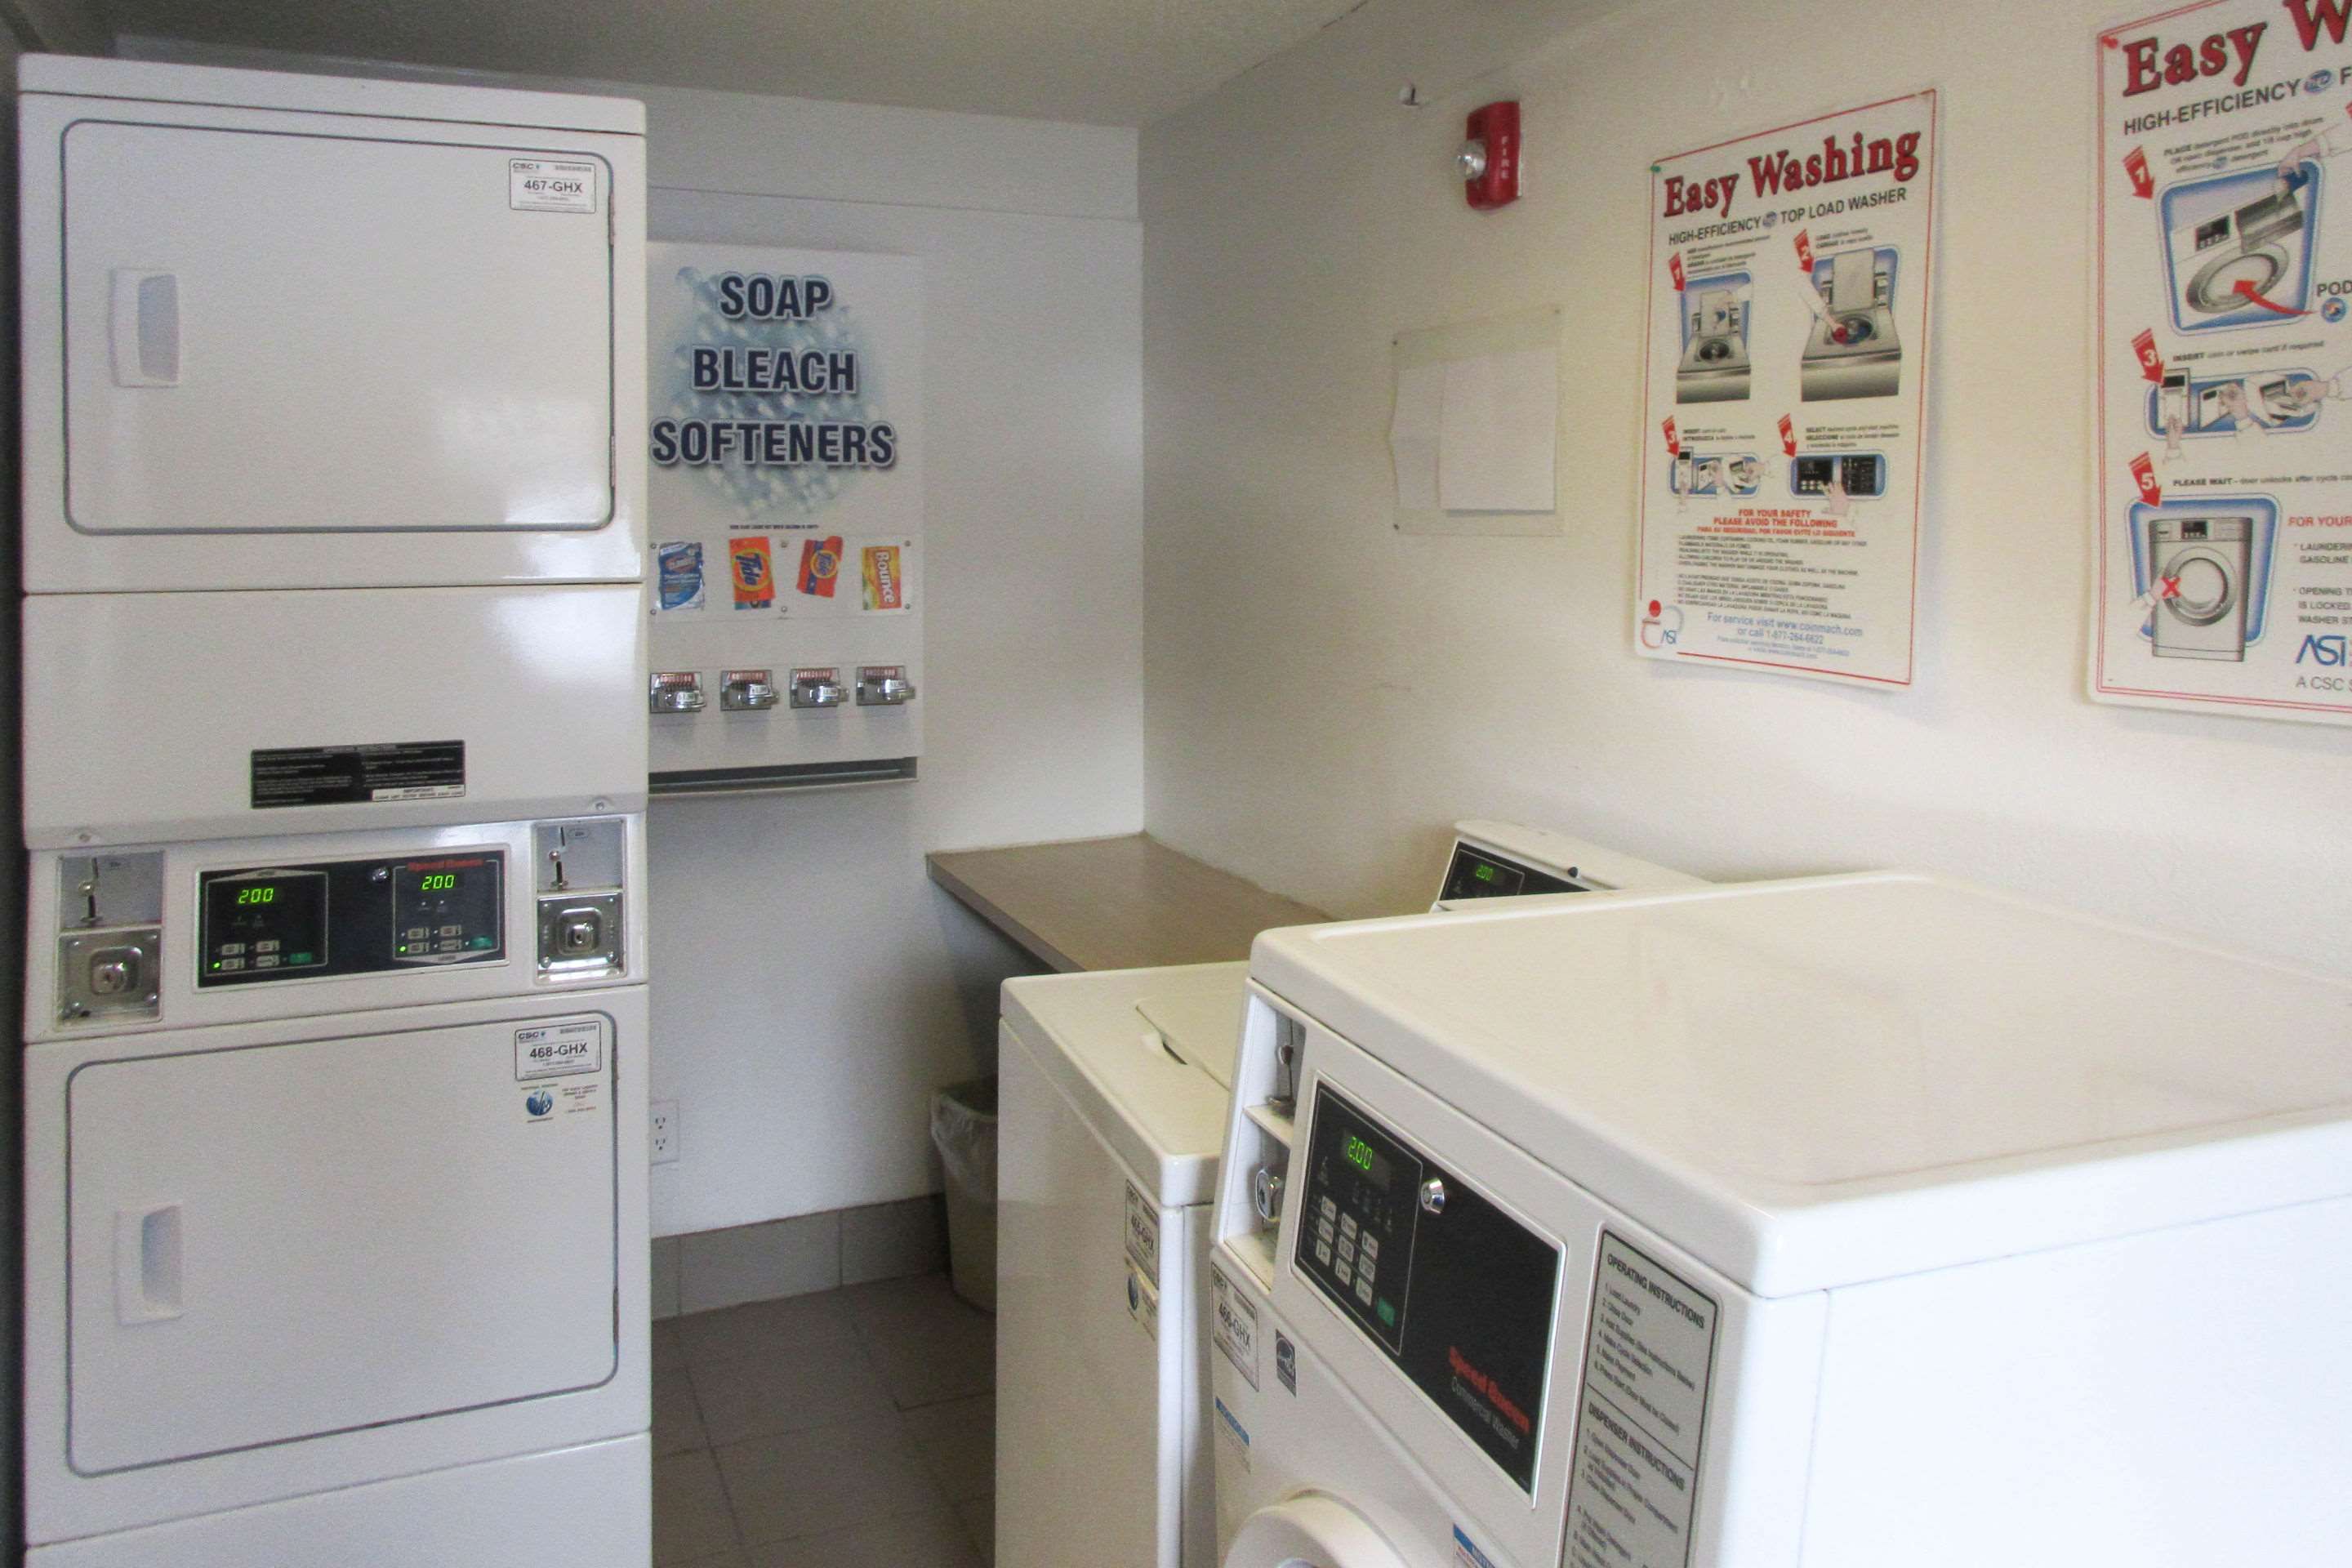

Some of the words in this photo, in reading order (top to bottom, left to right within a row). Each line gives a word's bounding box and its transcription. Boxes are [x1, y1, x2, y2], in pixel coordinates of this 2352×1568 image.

[2122, 20, 2268, 96] Easy
[2123, 78, 2300, 136] HIGH-EFFICIENCY
[1501, 136, 1510, 179] FIRE
[1663, 172, 1740, 219] Easy
[1748, 131, 1921, 198] Washing
[523, 180, 583, 194] 467-GHX
[1668, 216, 1762, 246] HIGH-EFFICIENCY
[1780, 207, 1806, 225] TOP
[1809, 198, 1845, 220] LOAD
[1848, 187, 1907, 212] WASHER
[719, 274, 831, 318] SOAP
[693, 348, 855, 392] BLEACH
[2144, 349, 2157, 367] 3
[652, 420, 893, 465] SOFTENERS
[2140, 473, 2154, 491] 5
[2173, 479, 2207, 487] PLEASE
[1713, 517, 1742, 525] PLEASE
[1745, 518, 1770, 526] AVOID
[1772, 519, 1787, 527] THE
[1789, 519, 1838, 528] FOLLOWING
[1739, 509, 1754, 517] FOR
[2287, 516, 2314, 528] FOR
[2295, 675, 2309, 688] A
[2310, 676, 2345, 692] CSC
[529, 1042, 588, 1058] 468-GHX
[1607, 1253, 1648, 1290] OPERATING
[1647, 1274, 1705, 1330] INSTRUCTIONS
[1588, 1401, 1628, 1443] DISPENSER
[1628, 1435, 1686, 1491] INSTRUCTIONS
